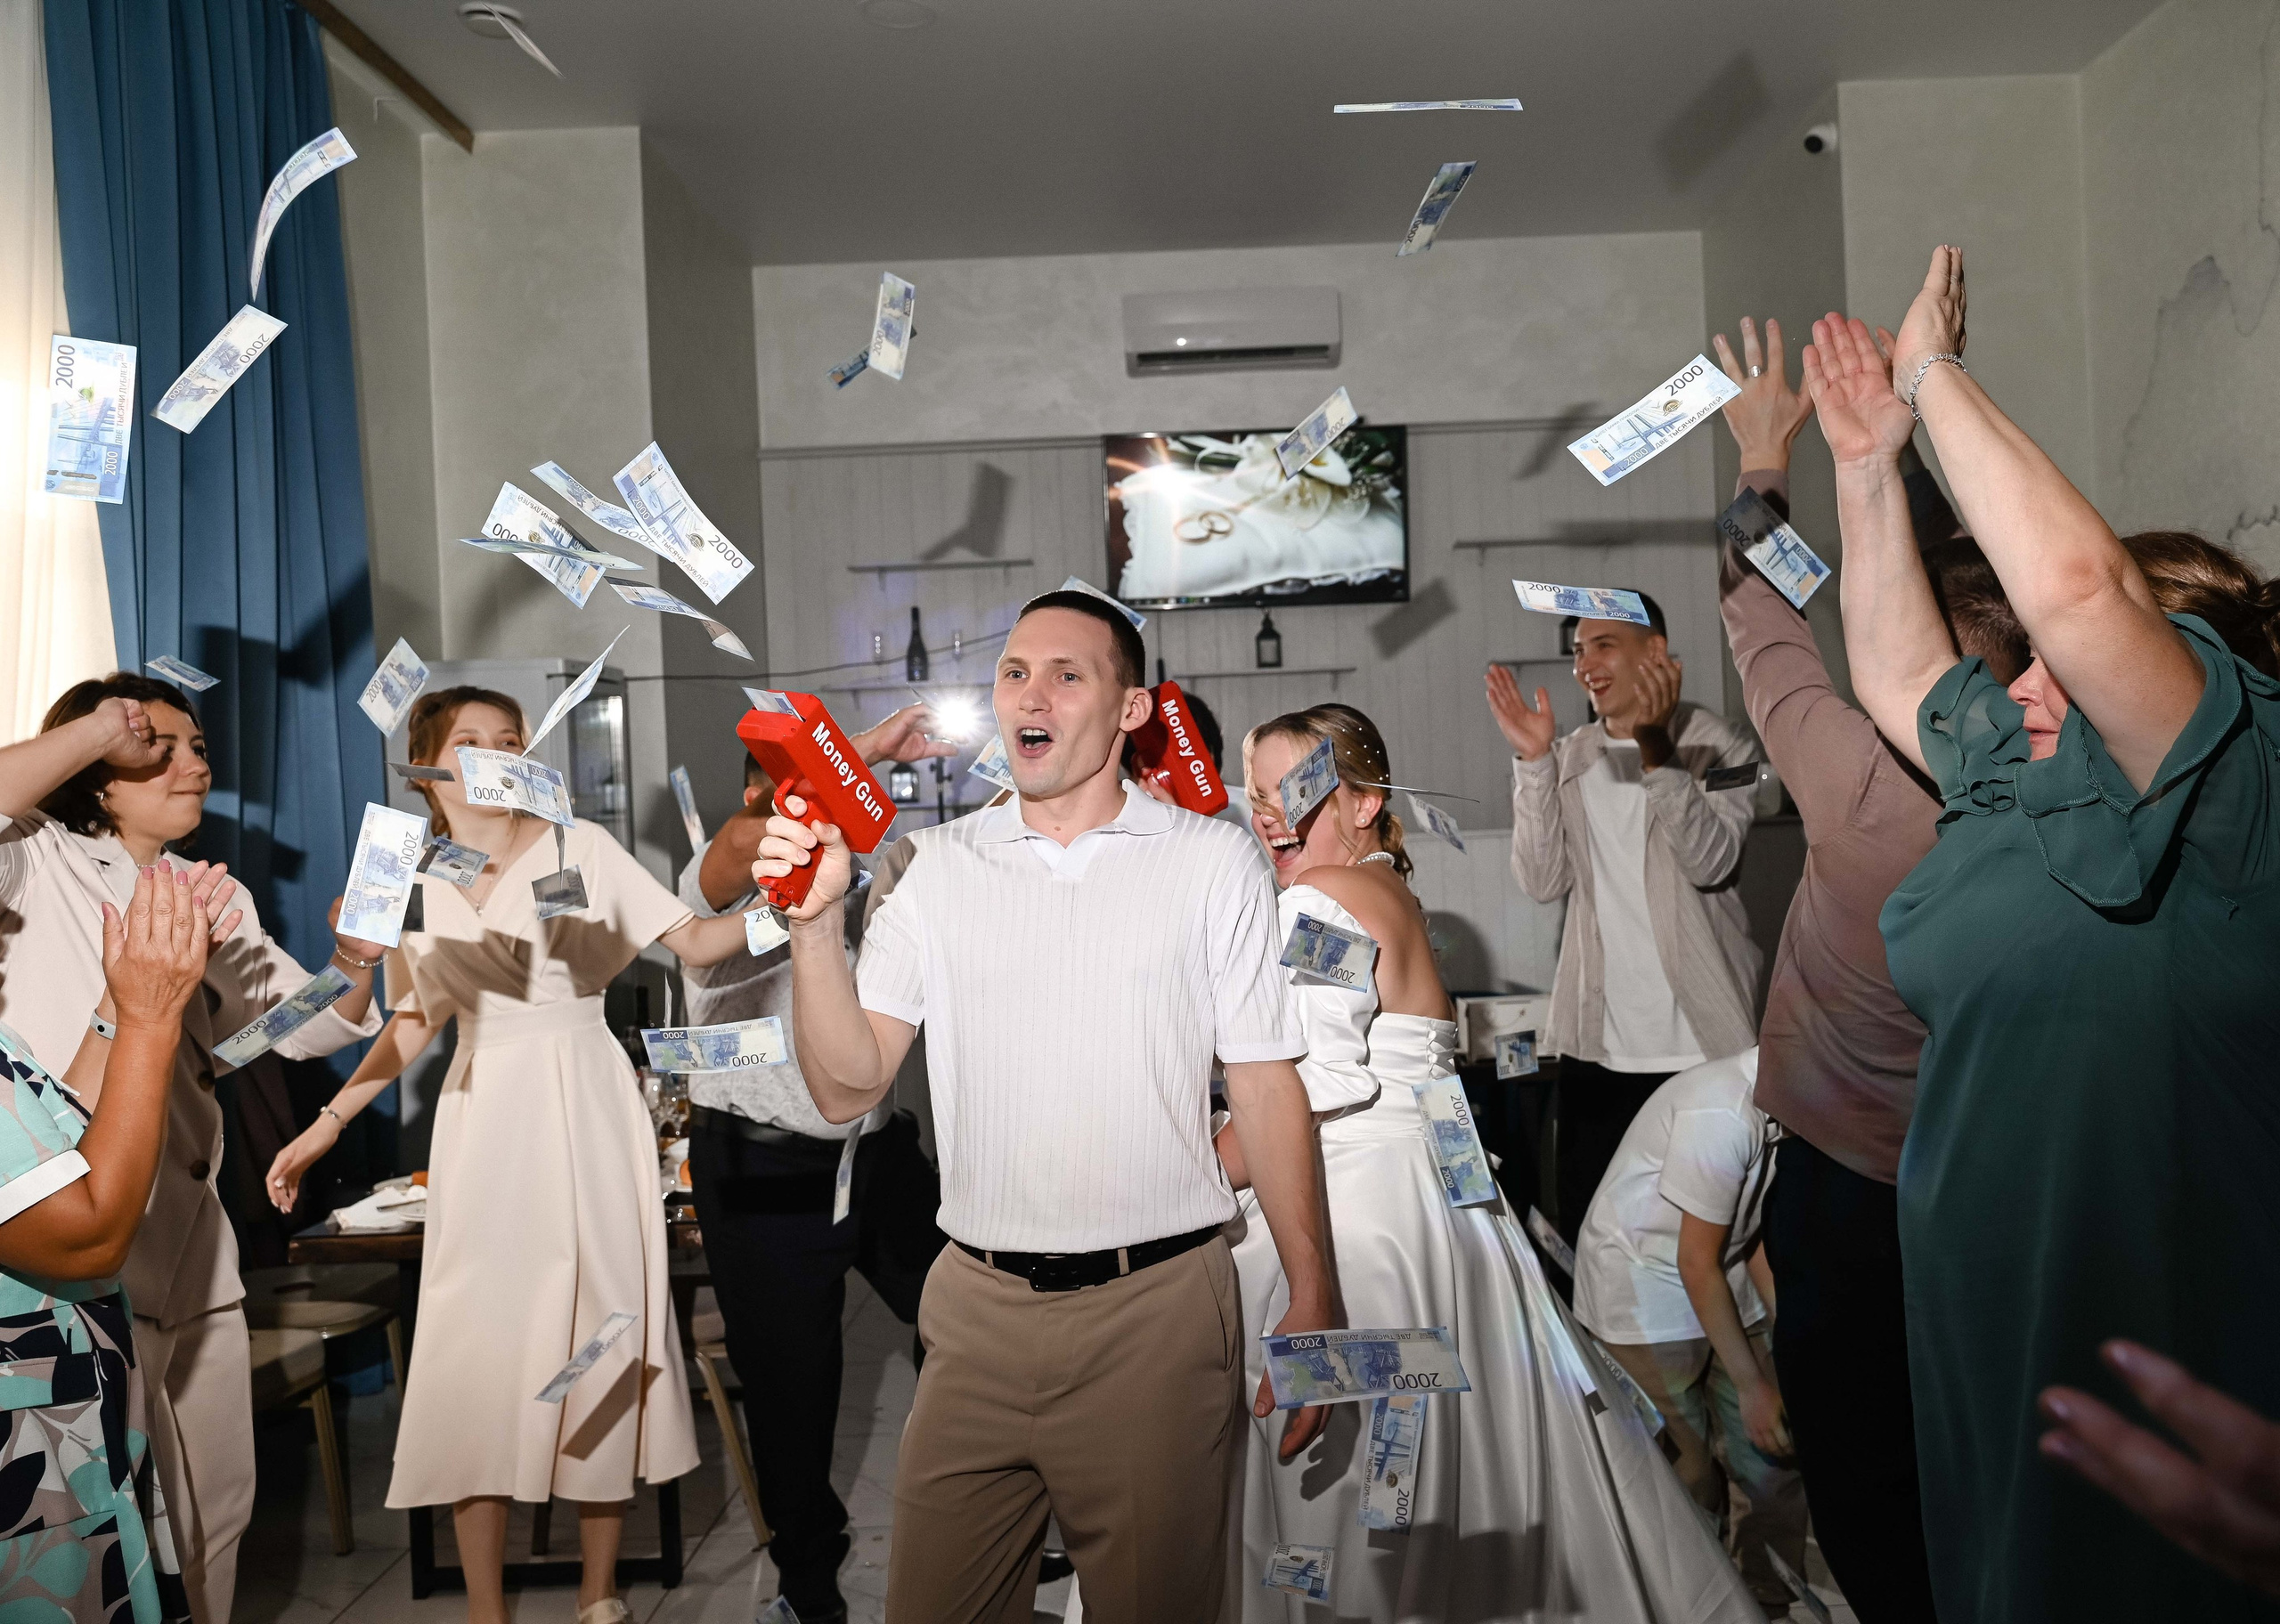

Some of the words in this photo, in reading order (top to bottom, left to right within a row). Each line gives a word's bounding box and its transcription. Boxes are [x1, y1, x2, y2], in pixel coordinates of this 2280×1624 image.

[240, 333, 270, 363] 2000
[55, 344, 75, 389] 2000
[119, 362, 128, 394] ДУБЛЕЙ
[1665, 364, 1704, 397] 2000
[168, 378, 188, 401] 2000
[116, 394, 126, 426] ТЫСЯЧИ
[1655, 436, 1668, 450] ДВЕ
[1668, 416, 1697, 439] ТЫСЯЧИ
[1696, 395, 1723, 419] ДУБЛЕЙ
[115, 429, 123, 445] ДВЕ
[104, 451, 118, 476] 2000
[1623, 447, 1649, 466] 2000
[517, 494, 542, 514] ДУБЛЕЙ
[632, 497, 650, 519] 2000
[1722, 518, 1752, 548] 2000
[648, 526, 661, 540] ДВЕ
[661, 538, 686, 564] ТЫСЯЧИ
[685, 563, 709, 588] ДУБЛЕЙ
[707, 534, 743, 569] 2000
[1796, 547, 1812, 564] 2000
[1527, 582, 1561, 594] 2000
[1608, 611, 1631, 619] 2000
[366, 679, 382, 703] 2000
[471, 751, 494, 760] ДУБЛЕЙ
[1161, 699, 1195, 757] Money
[1189, 759, 1212, 797] Gun
[532, 767, 549, 779] 2000
[811, 721, 858, 787] Money
[855, 781, 884, 822] Gun
[474, 786, 506, 802] 2000
[1289, 802, 1304, 824] 2000
[358, 840, 369, 867] ТЫСЯЧИ
[400, 831, 419, 865] 2000
[353, 867, 362, 890] ДУБЛЕЙ
[346, 891, 359, 914] 2000
[754, 909, 770, 922] 20
[1307, 921, 1322, 932] 2000
[1331, 966, 1356, 984] 2000
[318, 994, 338, 1010] 2000
[232, 1019, 267, 1045] 2000
[663, 1031, 685, 1040] 2000
[712, 1027, 738, 1035] ТЫСЯЧИ
[732, 1052, 768, 1068] 2000
[1450, 1093, 1470, 1126] 2000
[1442, 1169, 1454, 1189] 2000
[1291, 1336, 1323, 1350] 2000
[1327, 1335, 1358, 1344] ДУБЛЕЙ
[1361, 1334, 1395, 1342] ТЫСЯЧИ
[1392, 1372, 1442, 1390] 2000
[1373, 1412, 1384, 1435] 2000
[1395, 1488, 1410, 1525] 2000
